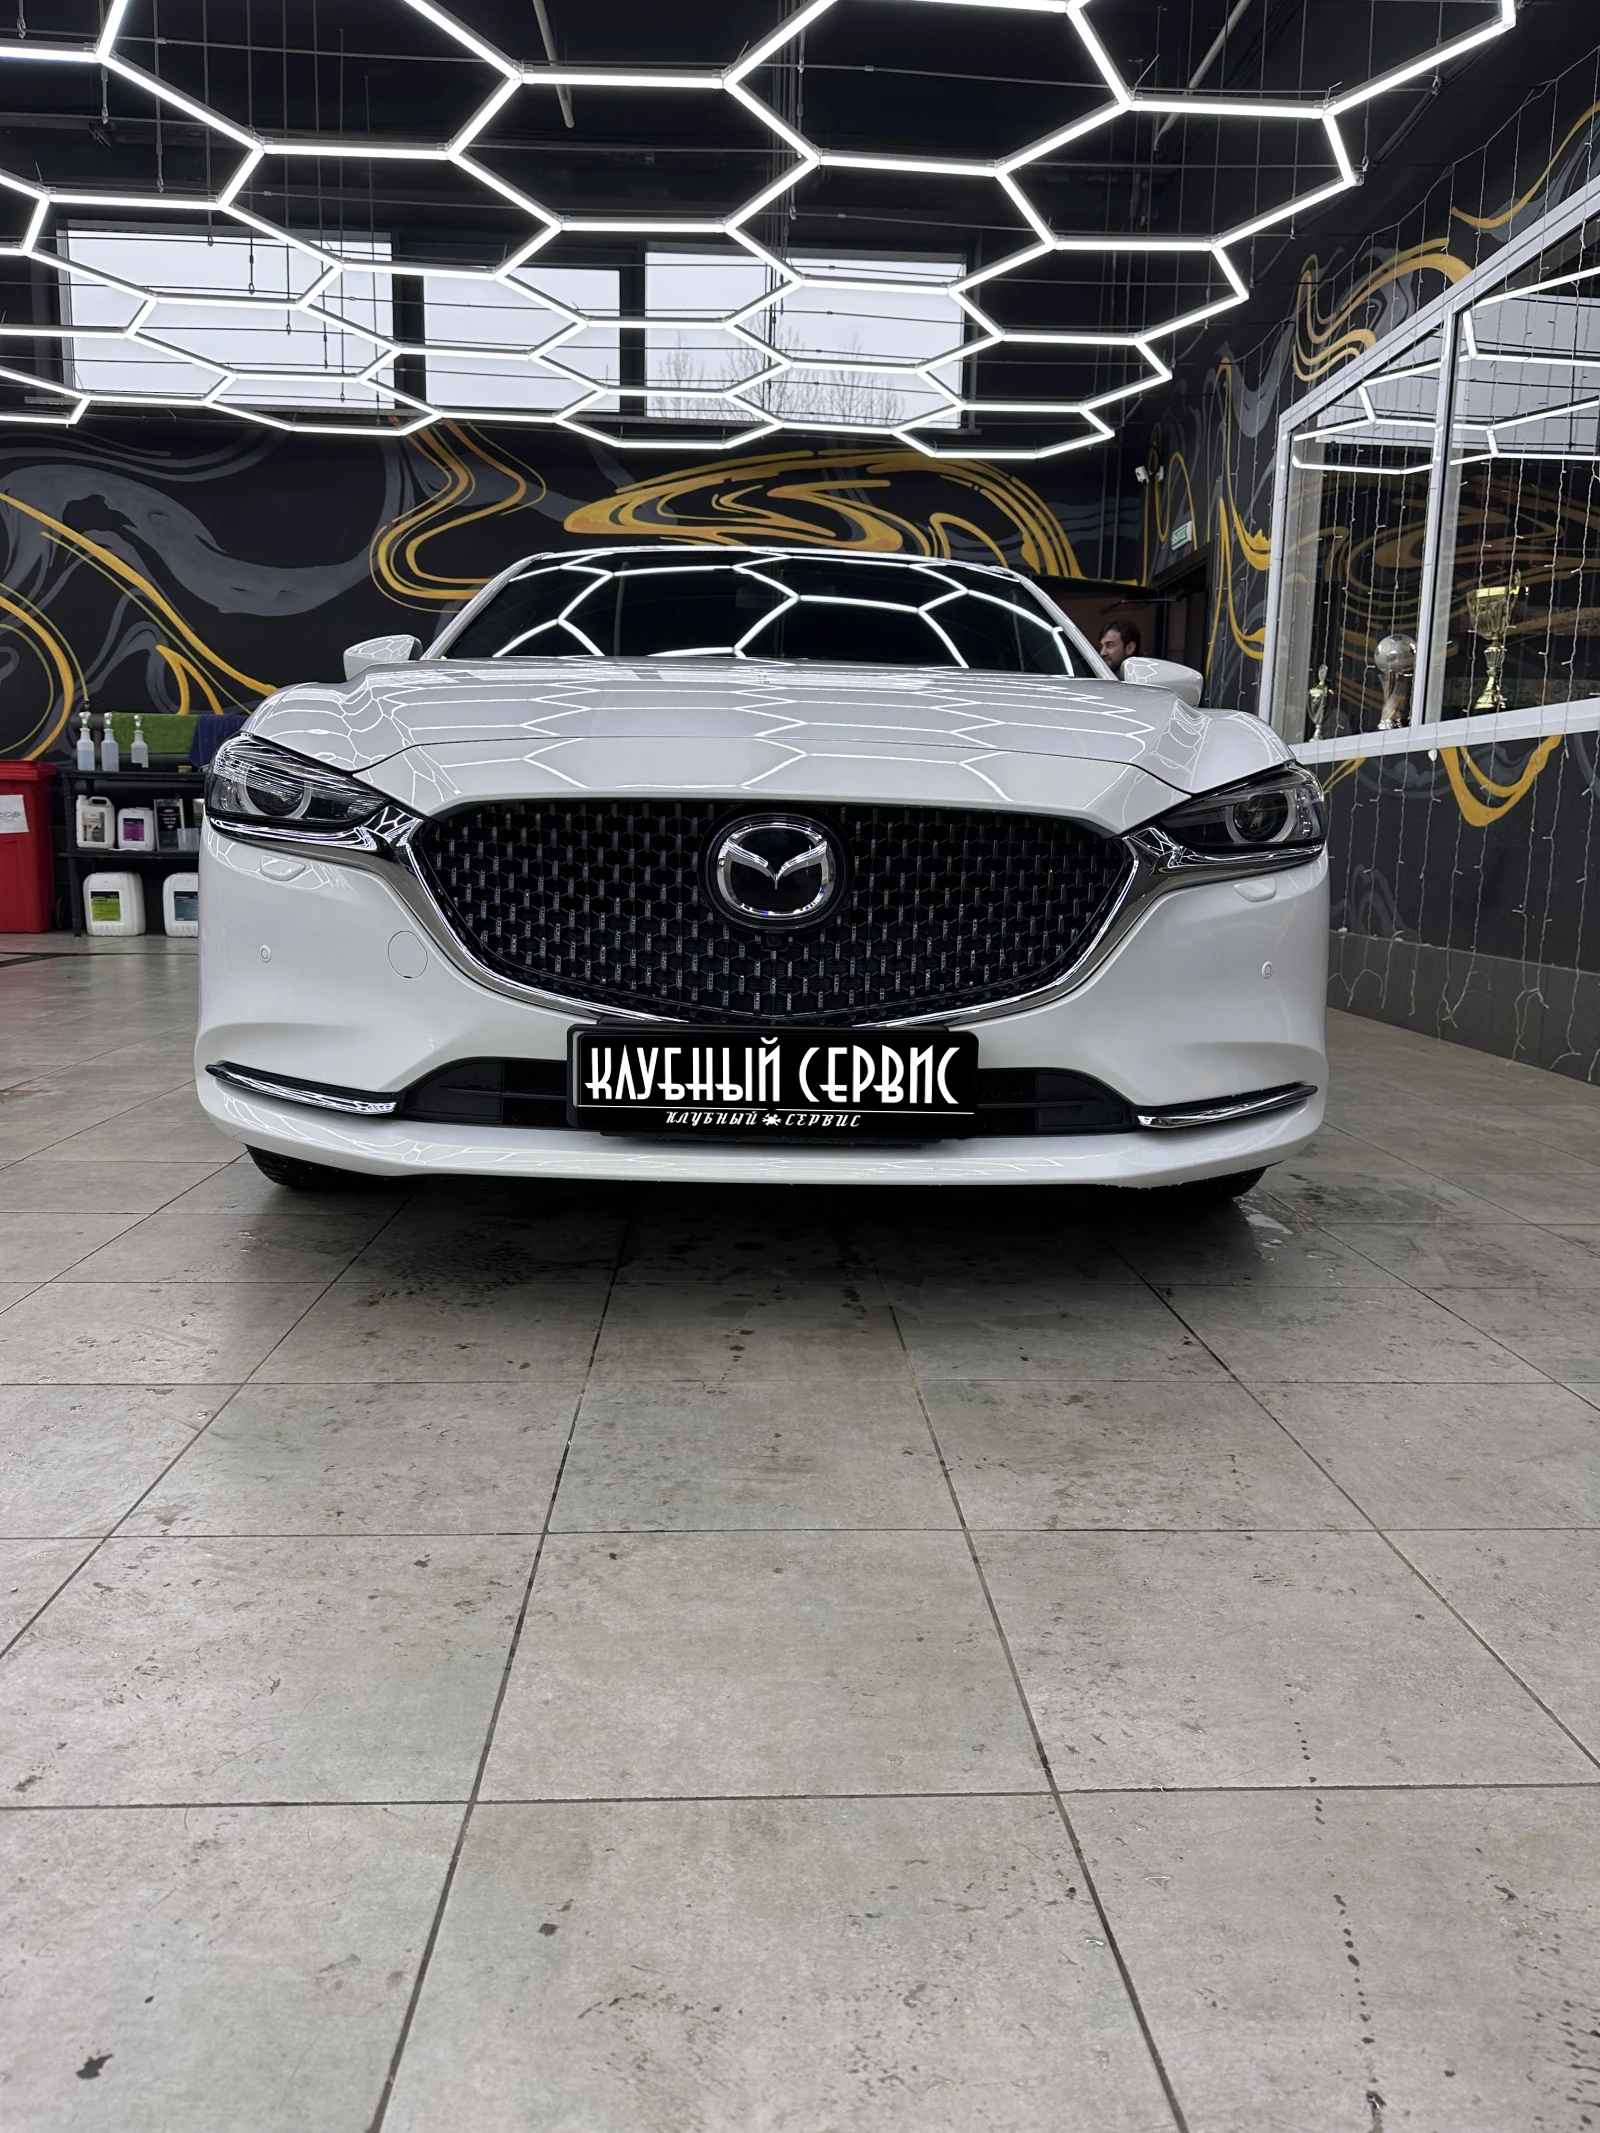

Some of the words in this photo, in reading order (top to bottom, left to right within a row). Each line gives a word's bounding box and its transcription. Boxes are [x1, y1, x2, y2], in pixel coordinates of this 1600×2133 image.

[585, 1037, 781, 1102] КЛУБНЫЙ
[799, 1044, 960, 1105] СЕРВИС
[665, 1111, 758, 1127] КЛУБНЫЙ
[785, 1113, 861, 1127] СЕРВИС
